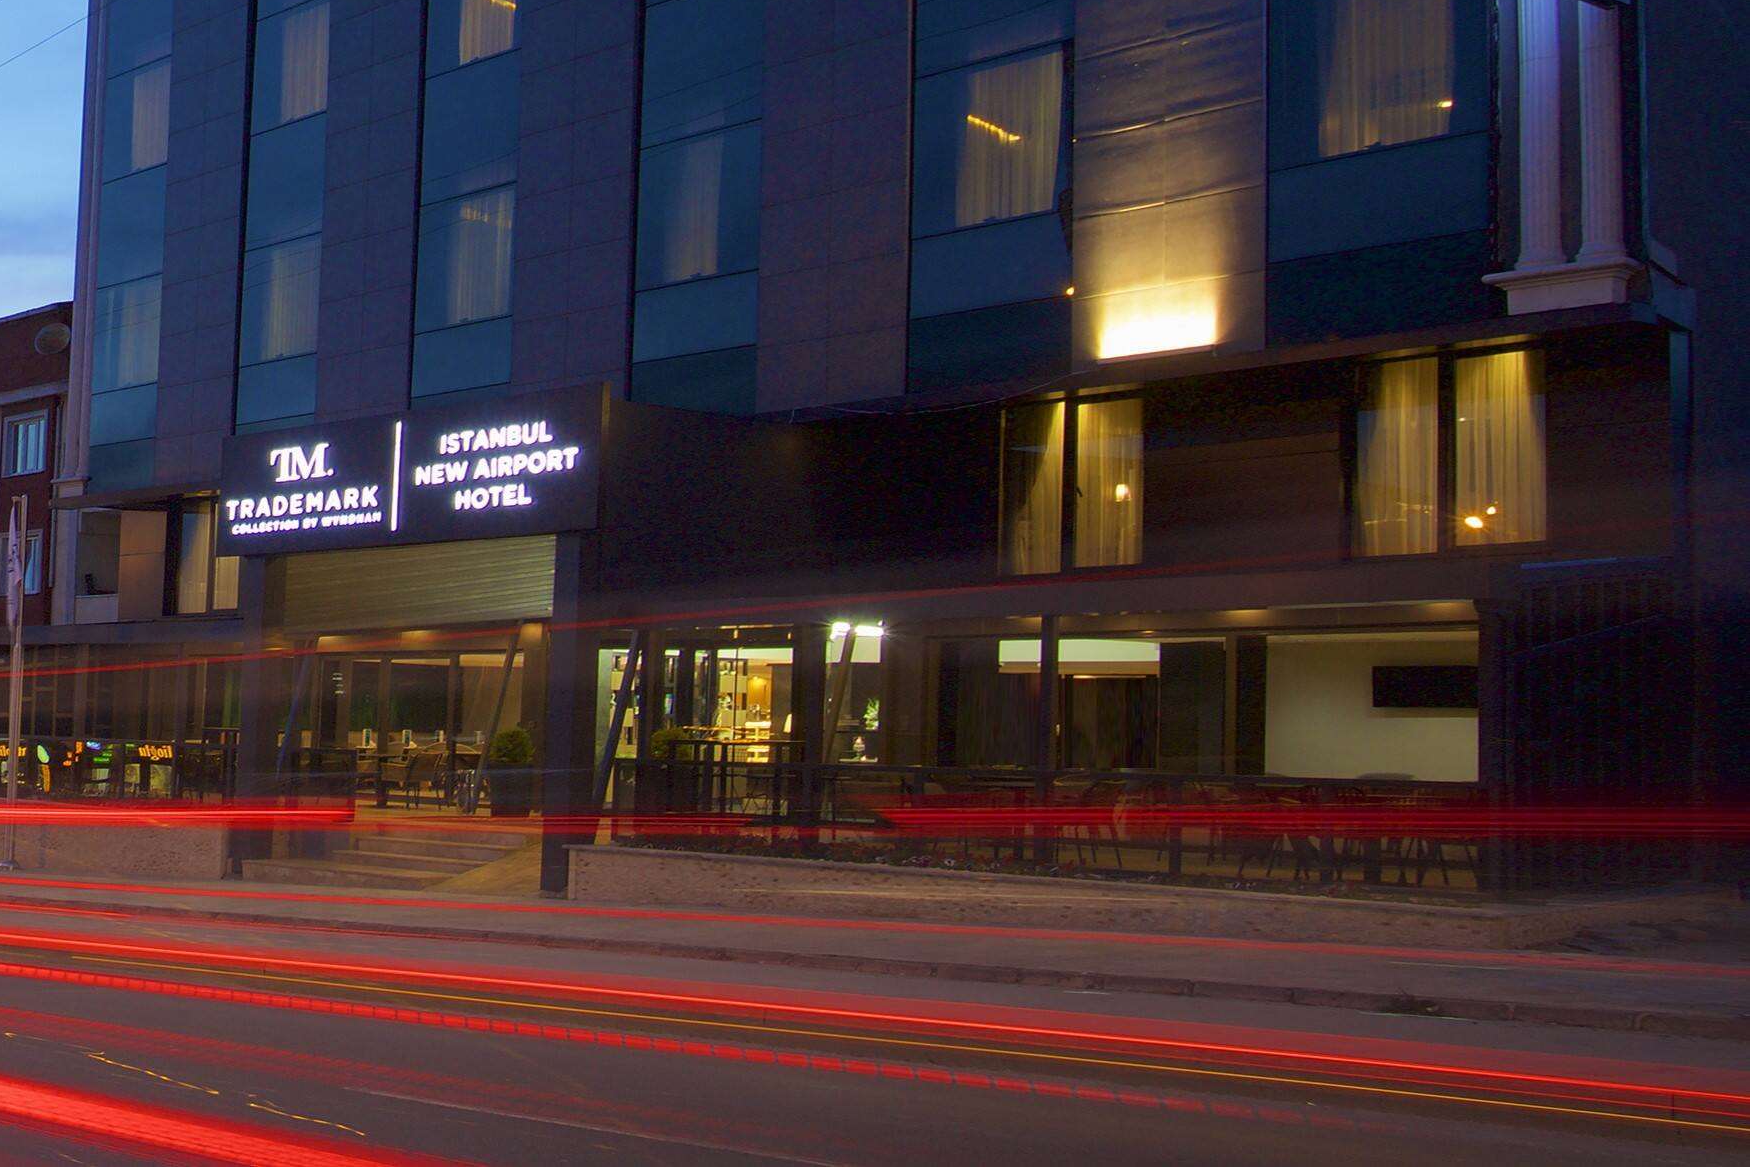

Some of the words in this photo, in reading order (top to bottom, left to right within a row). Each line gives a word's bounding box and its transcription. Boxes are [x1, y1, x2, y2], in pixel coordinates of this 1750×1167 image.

[439, 420, 554, 456] ISTANBUL
[415, 460, 469, 486] NEW
[473, 446, 580, 480] AIRPORT
[226, 485, 379, 521] TRADEMARK
[454, 483, 533, 511] HOTEL
